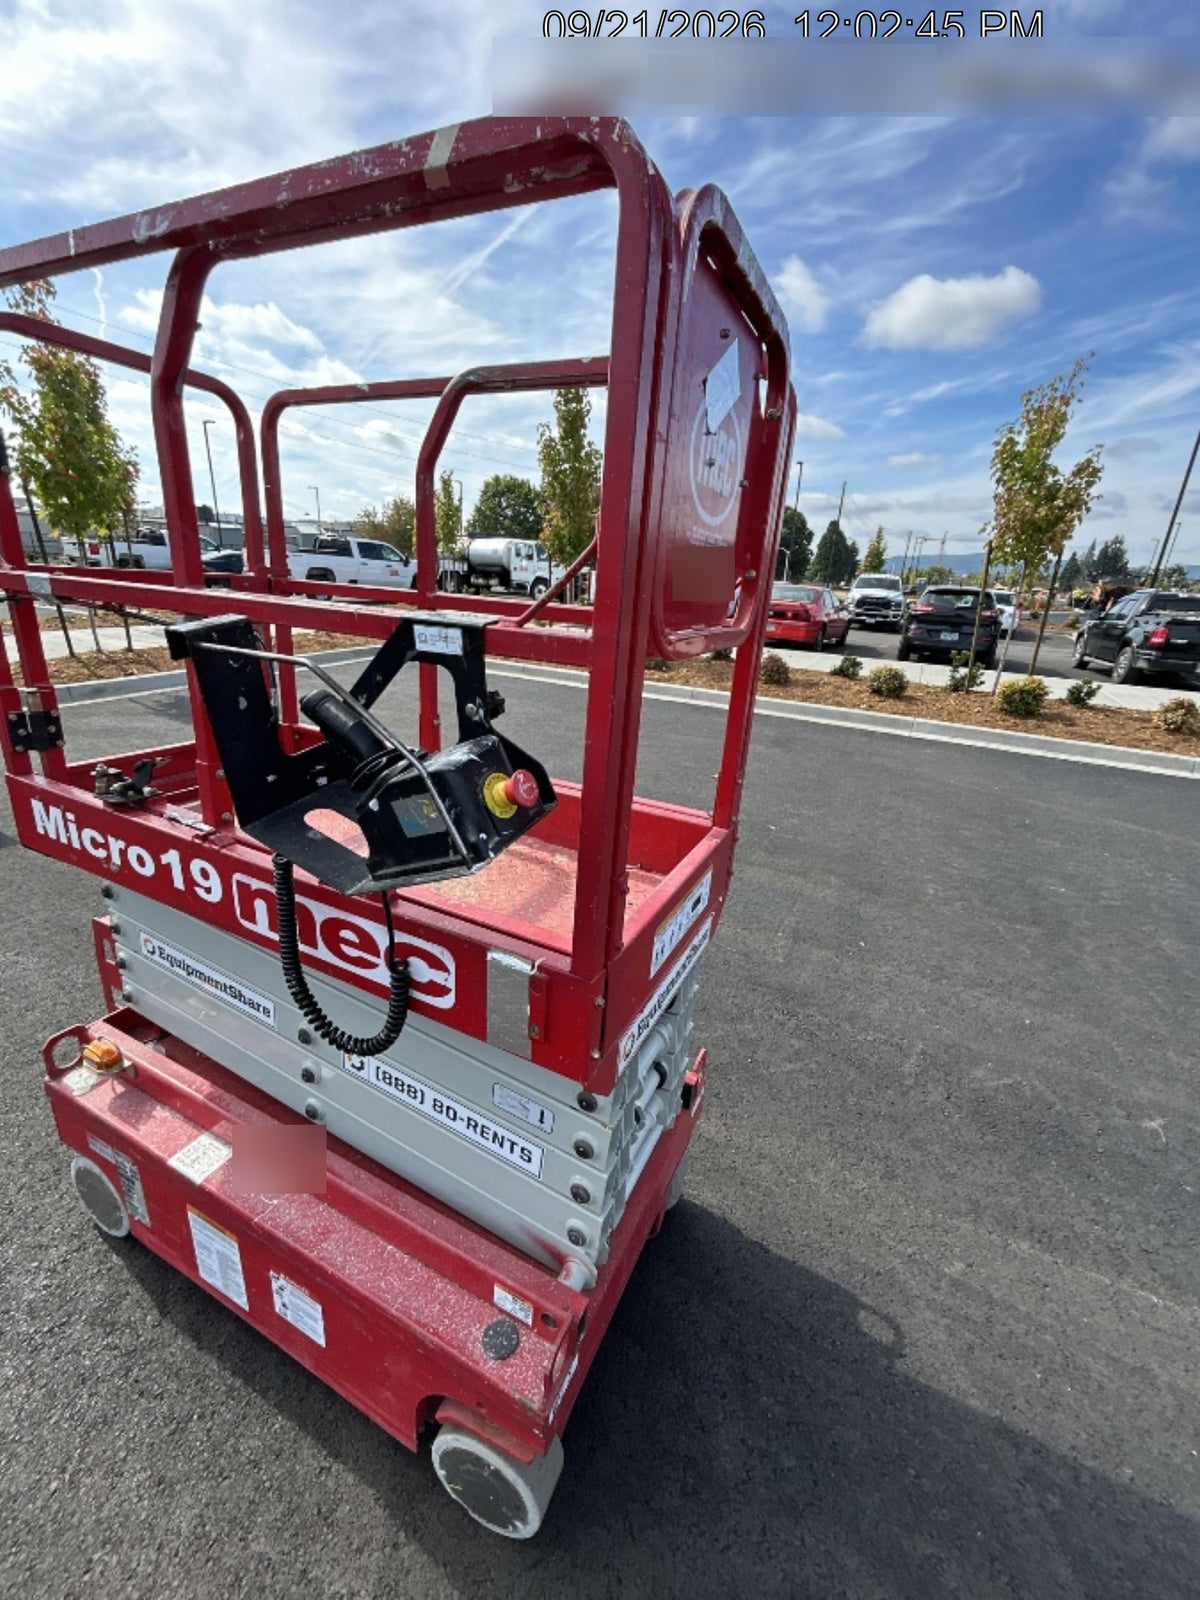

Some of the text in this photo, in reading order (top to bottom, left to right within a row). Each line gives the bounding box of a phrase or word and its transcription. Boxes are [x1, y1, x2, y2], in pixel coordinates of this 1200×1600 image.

[30, 797, 223, 904] Micro19
[156, 945, 272, 1023] EquipmentShare
[234, 876, 454, 1002] mec
[374, 1065, 533, 1165] (888) 80-RENTS
